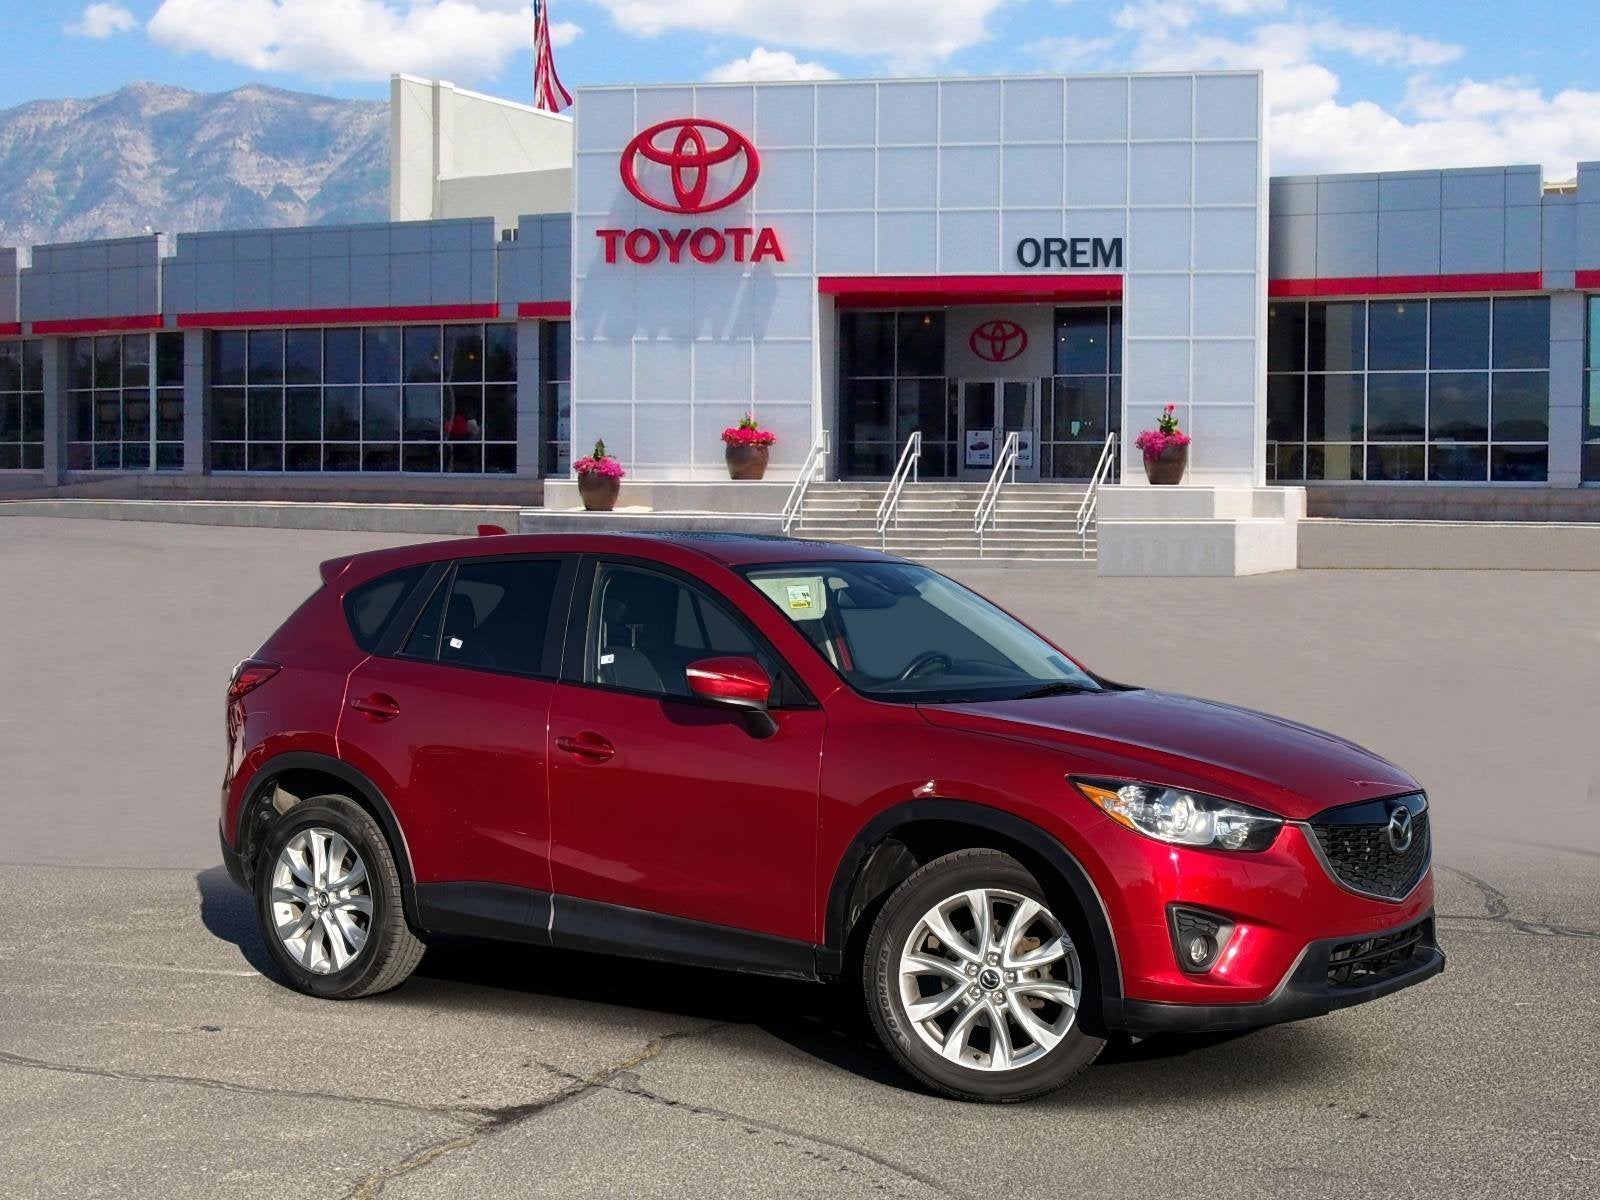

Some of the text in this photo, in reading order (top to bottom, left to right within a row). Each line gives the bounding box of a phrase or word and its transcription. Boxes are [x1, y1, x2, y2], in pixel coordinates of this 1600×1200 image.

[596, 227, 785, 264] TOYOTA
[1016, 237, 1123, 268] OREM
[878, 948, 909, 1047] YOKOHAMA
